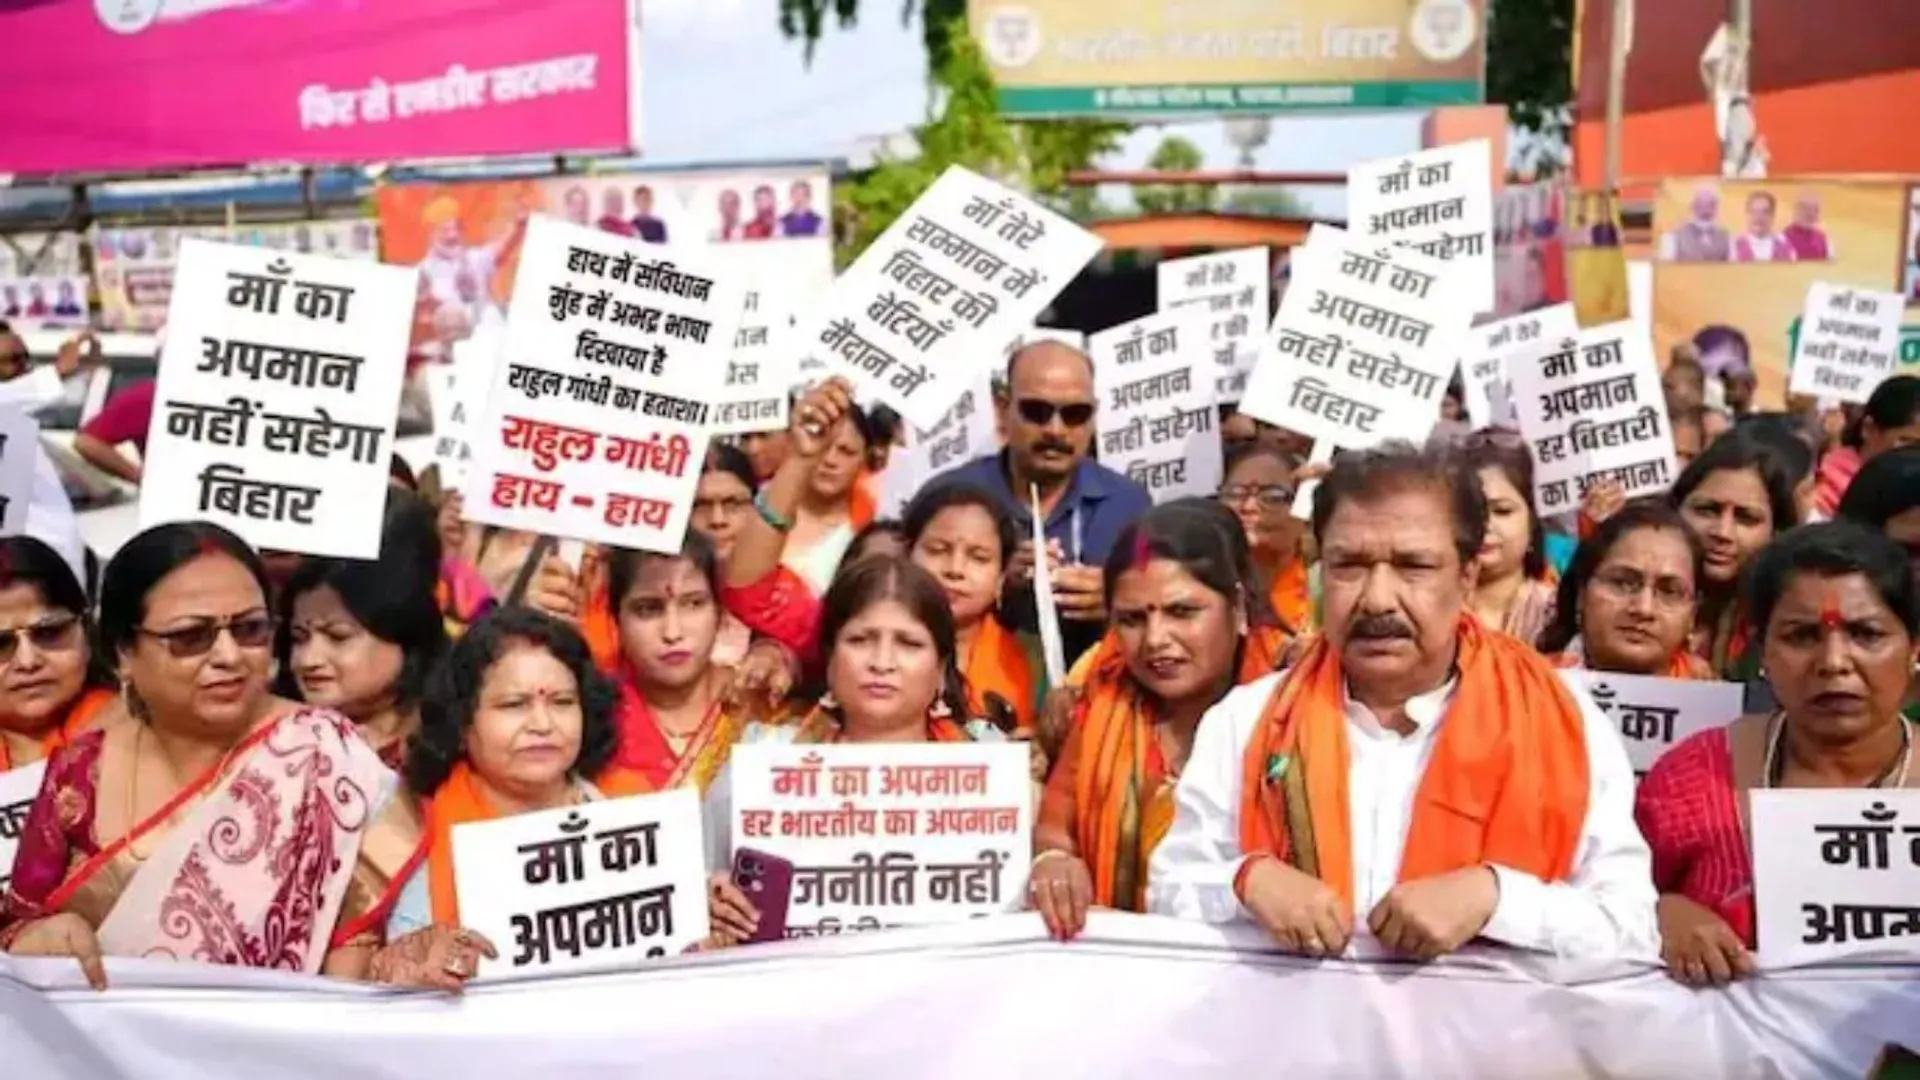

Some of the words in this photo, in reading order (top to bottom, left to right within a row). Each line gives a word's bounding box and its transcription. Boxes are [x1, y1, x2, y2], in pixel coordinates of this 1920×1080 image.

[490, 53, 598, 104] सरकार
[1377, 159, 1414, 194] माँ
[1417, 161, 1452, 187] का
[962, 194, 1012, 230] माँ
[997, 211, 1047, 250] तेरे
[1368, 195, 1466, 235] अपमान
[567, 245, 606, 278] हाथ
[610, 251, 634, 284] में
[634, 261, 714, 302] संविधान
[904, 214, 1006, 283] सम्मान
[1002, 267, 1049, 300] में
[1339, 246, 1392, 285] माँ
[1391, 261, 1438, 299] का
[228, 258, 293, 318] माँ
[295, 280, 355, 324] का
[548, 284, 583, 321] मुंह
[586, 287, 611, 321] में
[611, 300, 660, 335] अभद्र
[664, 313, 712, 345] भाषा
[880, 249, 958, 306] बिहार
[951, 291, 1000, 329] की
[866, 291, 956, 353] बेटियाँ
[1114, 324, 1146, 366] माँ
[1148, 326, 1179, 356] का
[1309, 289, 1434, 348] अपमान
[196, 336, 365, 393] अपमान
[575, 329, 646, 373] दिखाया
[650, 347, 669, 376] है
[820, 316, 899, 379] मैदान
[889, 364, 937, 399] में
[1277, 326, 1353, 370] नहीं
[1346, 346, 1446, 402] सहेगा
[1538, 337, 1580, 378] माँ
[1585, 337, 1625, 369] का
[508, 363, 562, 398] राहुल
[565, 375, 612, 408] गांधी
[612, 389, 641, 412] का
[1110, 366, 1193, 411] अपमान
[1287, 377, 1386, 434] बिहार
[1539, 373, 1638, 424] अपमान
[166, 395, 263, 448] नहीं
[262, 408, 385, 464] सहेगा
[502, 414, 601, 471] राहुल
[604, 430, 691, 478] गांधी
[1102, 413, 1150, 455] नहीं
[1148, 405, 1214, 445] सहेगा
[1535, 428, 1571, 466] हर
[1569, 405, 1661, 453] बिहारी
[198, 464, 322, 525] बिहार
[490, 473, 563, 513] हाय
[603, 491, 677, 530] हाय
[1539, 480, 1571, 506] का
[1618, 703, 1680, 743] का
[771, 750, 825, 797] माँ
[829, 764, 870, 797] का
[879, 763, 990, 797] अपमान
[740, 808, 775, 839] हर
[779, 801, 877, 839] भारतीय
[883, 808, 918, 836] का
[921, 805, 1019, 836] अपमान
[1814, 801, 1900, 871] माँ
[518, 811, 589, 887] माँ
[599, 820, 661, 873] का
[793, 851, 919, 907] जनीति
[925, 850, 1012, 903] नहीं
[511, 883, 676, 967] अपमान
